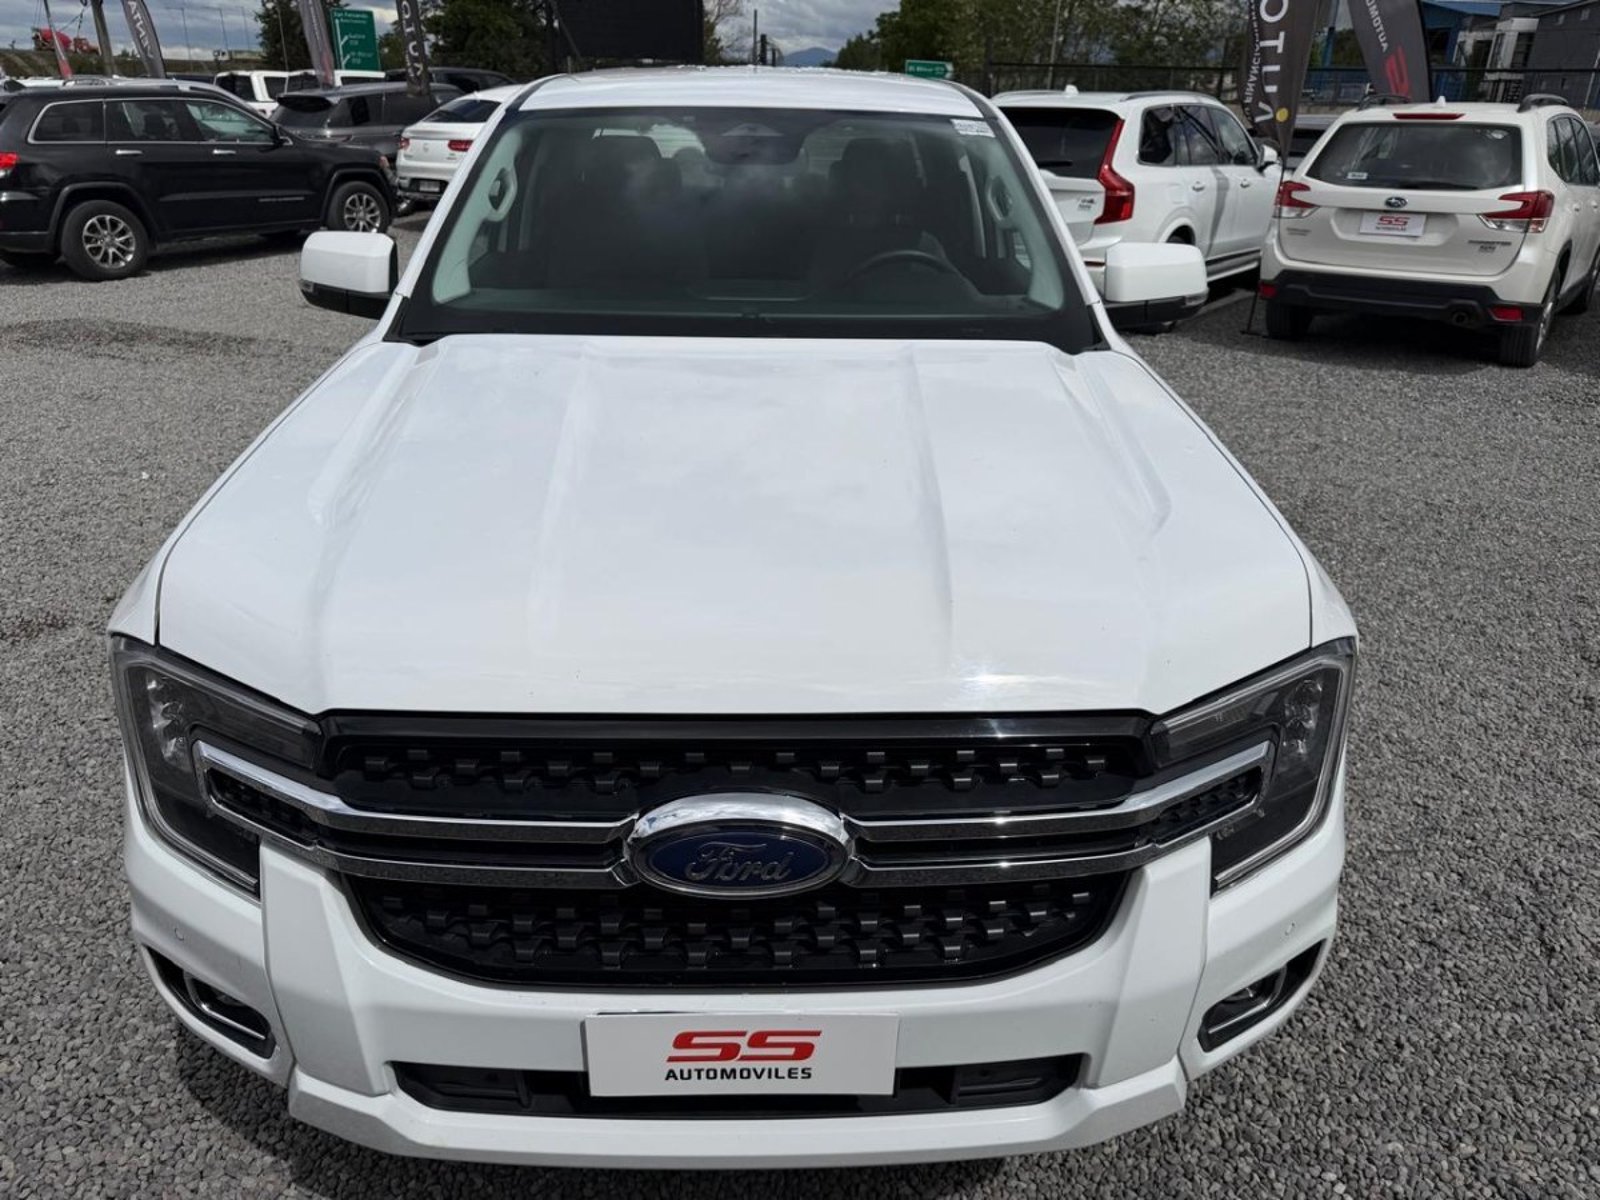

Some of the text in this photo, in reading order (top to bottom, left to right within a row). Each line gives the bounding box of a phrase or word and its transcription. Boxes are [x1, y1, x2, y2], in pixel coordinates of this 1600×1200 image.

[1376, 215, 1411, 226] SS
[685, 841, 794, 880] Ford
[666, 1030, 822, 1063] SS
[664, 1067, 812, 1081] AUTOMOVILES
